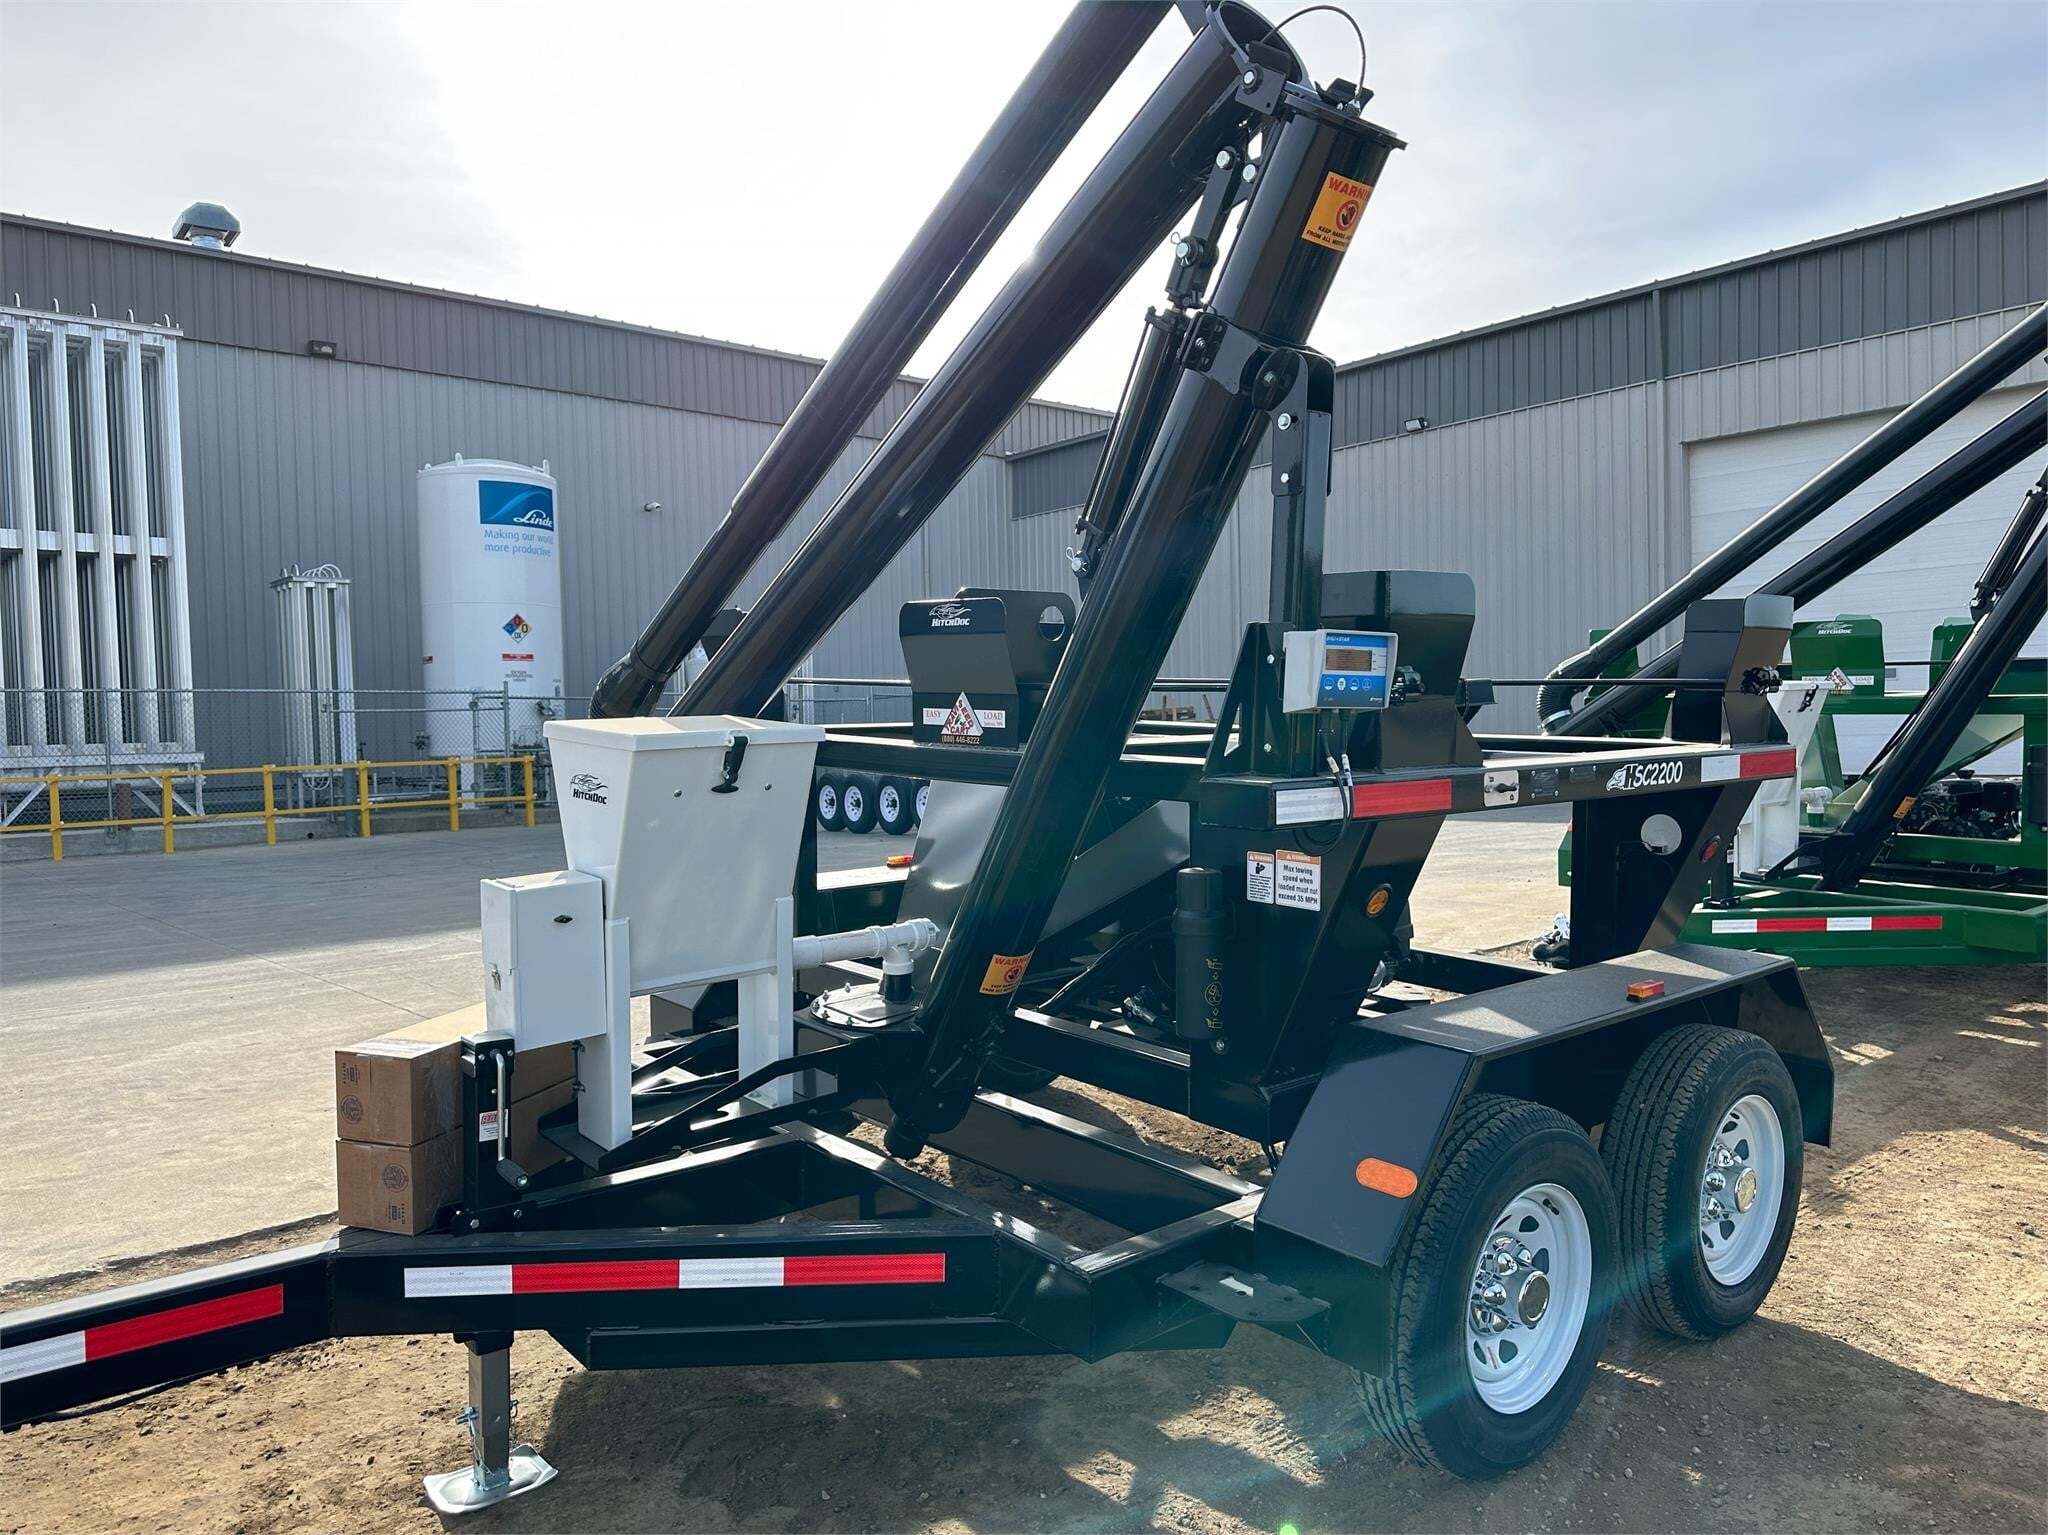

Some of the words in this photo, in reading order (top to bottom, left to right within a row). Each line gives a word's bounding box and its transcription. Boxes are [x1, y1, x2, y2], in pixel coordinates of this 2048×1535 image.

[513, 509, 553, 528] Linde
[484, 529, 520, 542] Making
[522, 533, 535, 541] our
[484, 544, 510, 552] more
[926, 710, 942, 718] EASY
[983, 711, 1003, 720] LOAD
[950, 726, 971, 735] CART
[1283, 864, 1294, 872] Max
[1295, 866, 1313, 876] towing
[1282, 875, 1298, 884] speed
[1299, 877, 1314, 885] when
[1279, 883, 1295, 891] loaded
[1278, 893, 1296, 901] exceed
[1297, 894, 1304, 902] 35
[1305, 896, 1318, 905] MPH
